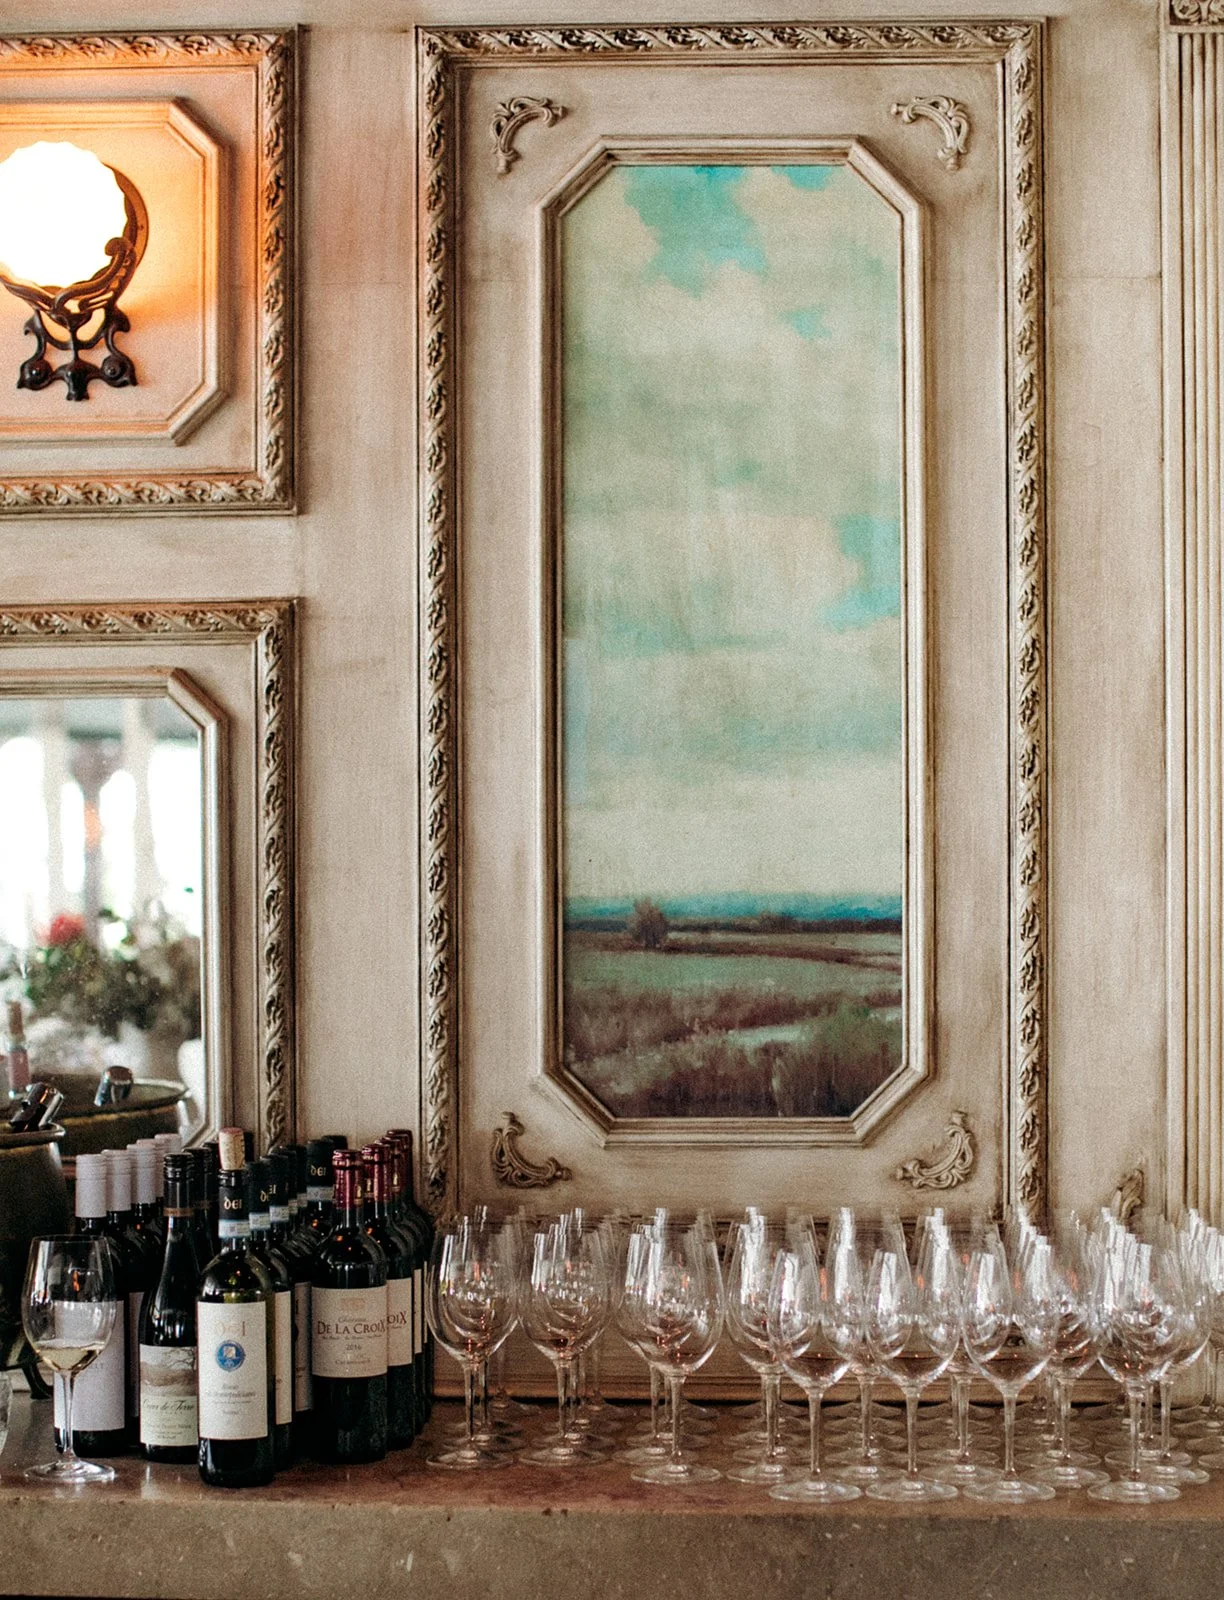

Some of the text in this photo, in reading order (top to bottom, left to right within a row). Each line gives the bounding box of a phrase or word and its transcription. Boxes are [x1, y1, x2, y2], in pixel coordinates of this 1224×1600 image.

[387, 1311, 407, 1325] OIX
[335, 1323, 350, 1334] LA
[353, 1319, 386, 1334] CROIX
